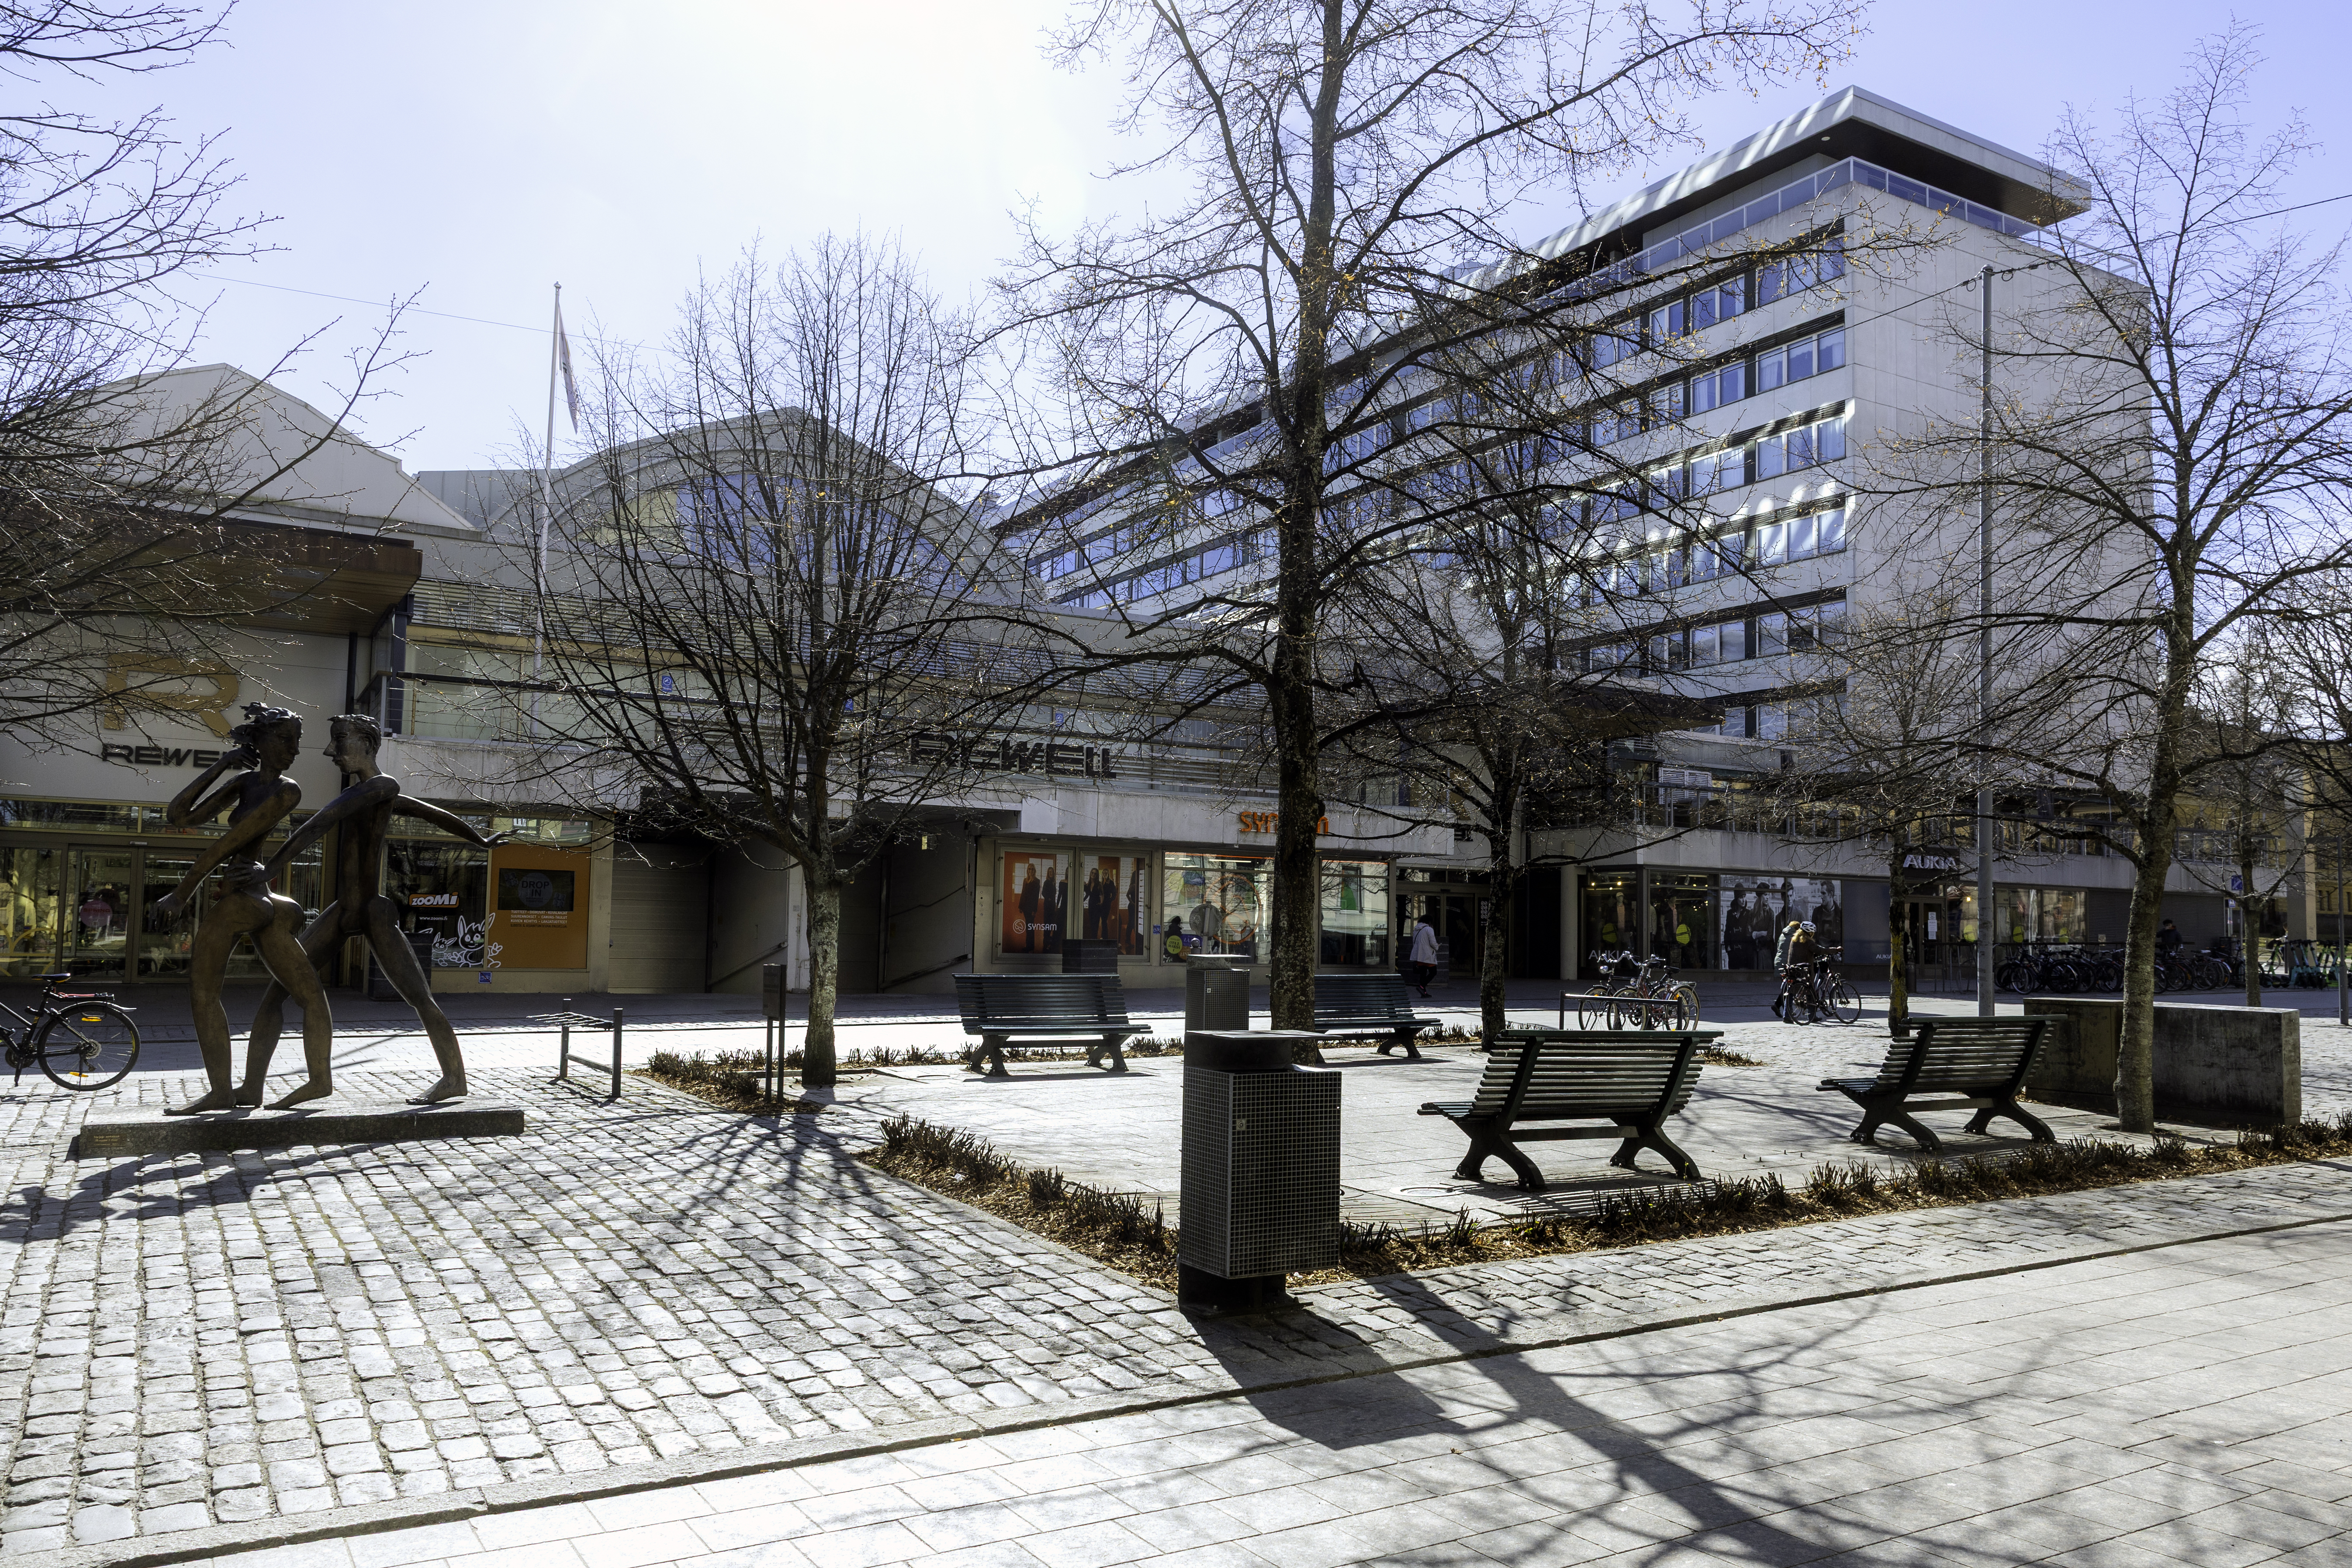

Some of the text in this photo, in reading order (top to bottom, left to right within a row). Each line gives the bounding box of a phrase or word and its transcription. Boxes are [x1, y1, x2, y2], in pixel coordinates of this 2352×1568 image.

[910, 733, 1117, 779] REWELL
[1903, 855, 1958, 870] AUKIA
[522, 880, 550, 889] DROP
